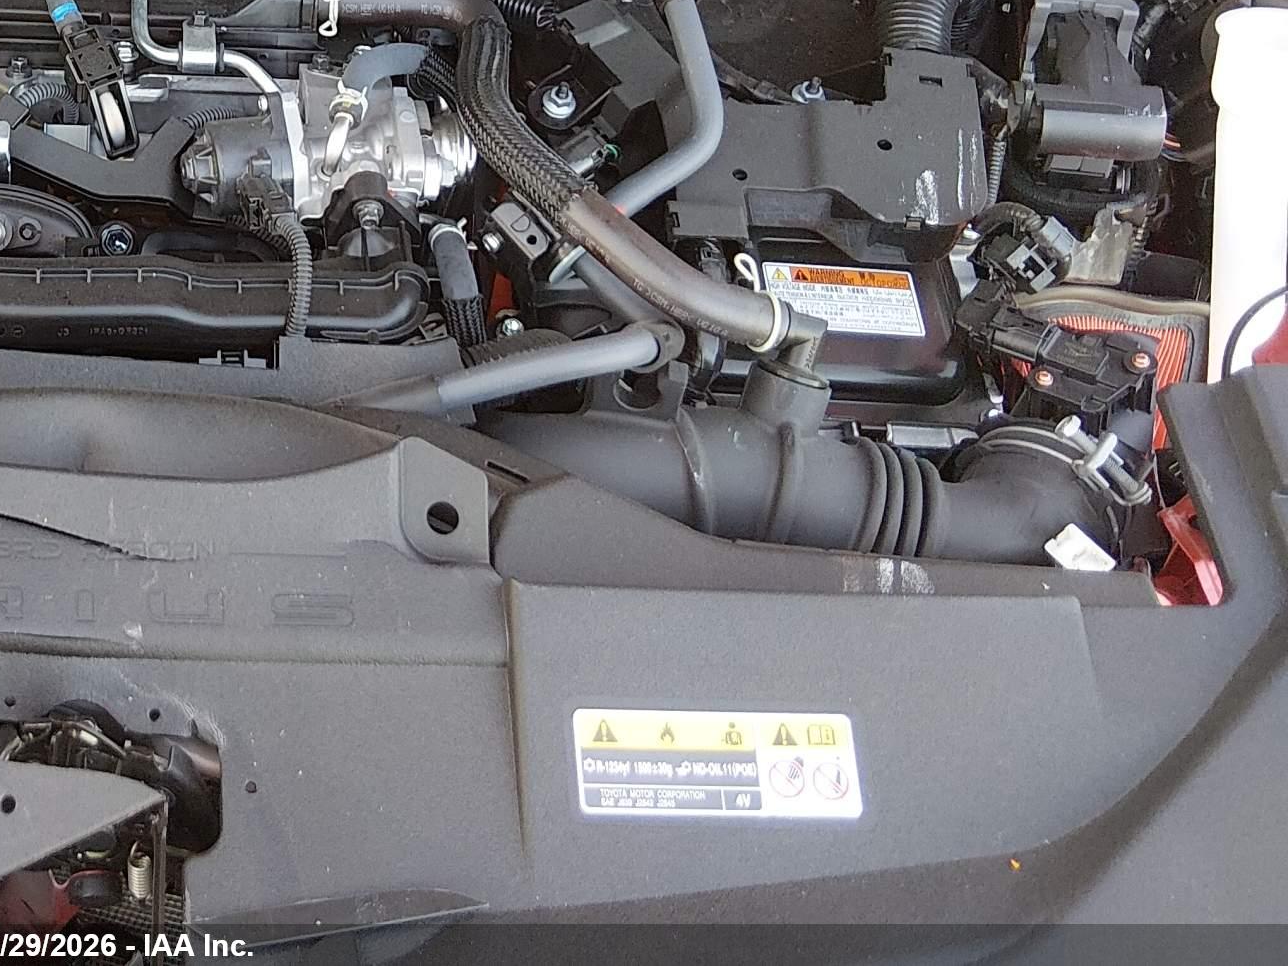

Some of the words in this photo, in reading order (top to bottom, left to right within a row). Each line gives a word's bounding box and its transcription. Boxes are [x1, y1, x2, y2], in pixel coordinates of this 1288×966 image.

[600, 788, 627, 798] TOYOTA
[630, 789, 655, 799] MOTOR
[657, 789, 706, 800] CORPORATION
[735, 793, 752, 809] 4V
